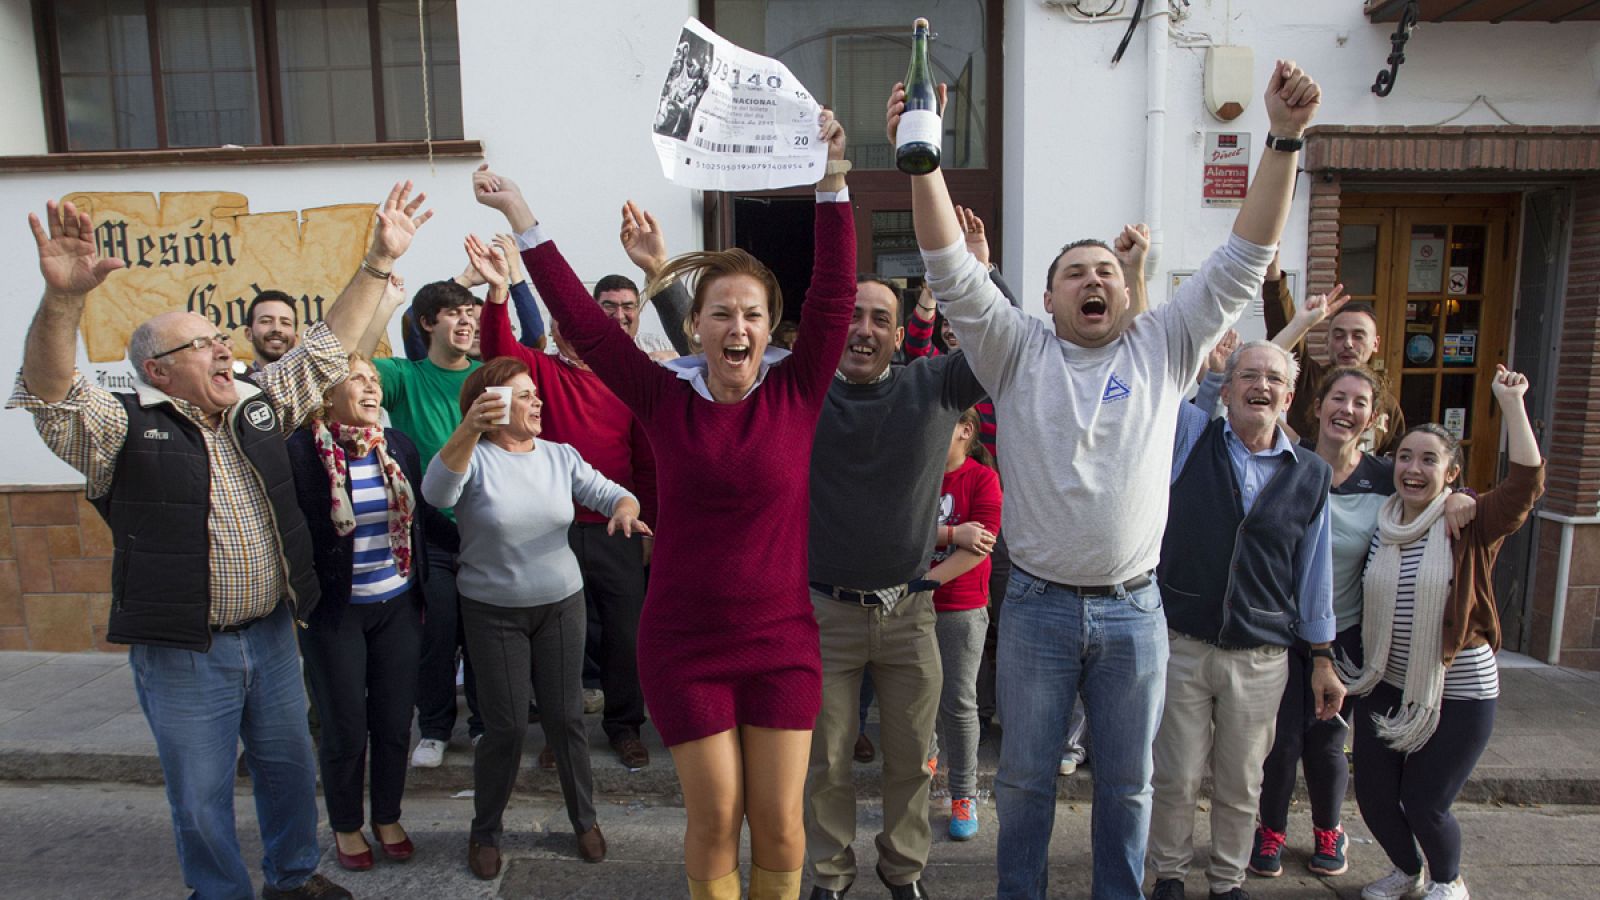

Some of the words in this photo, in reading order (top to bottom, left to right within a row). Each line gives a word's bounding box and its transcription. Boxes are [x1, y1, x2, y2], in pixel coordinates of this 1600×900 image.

[712, 57, 782, 89] 79140
[732, 97, 778, 106] NACIONAL
[793, 135, 809, 147] 20
[1207, 167, 1246, 177] Alarma
[95, 217, 237, 269] Mesón
